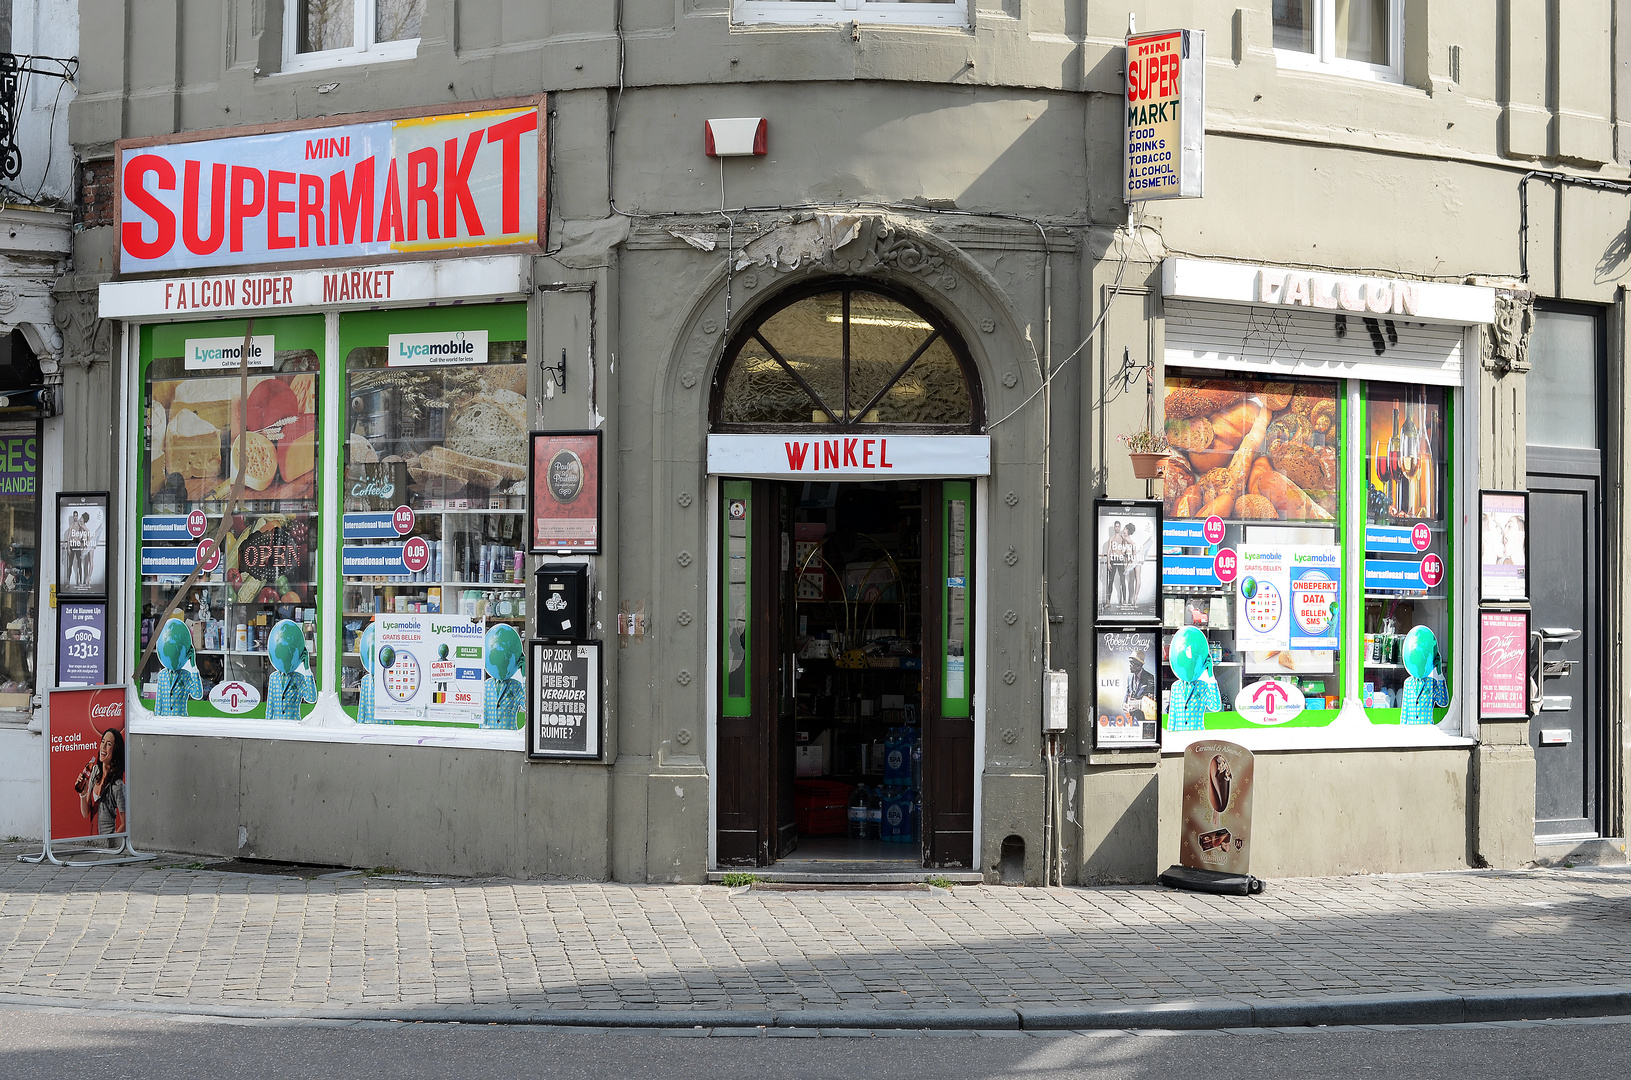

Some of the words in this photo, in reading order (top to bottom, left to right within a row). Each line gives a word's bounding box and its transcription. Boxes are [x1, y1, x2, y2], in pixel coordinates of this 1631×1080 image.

[1138, 41, 1170, 56] MINI
[1128, 53, 1180, 102] SUPER
[1128, 100, 1180, 127] MARKT
[1129, 128, 1155, 140] FOOD
[305, 136, 350, 160] MINI
[1129, 139, 1166, 154] DRINKS
[1129, 151, 1171, 166] TOBACCO
[1128, 163, 1174, 178] ALCOHOL
[121, 110, 538, 259] SUPERMARKT
[164, 279, 236, 309] FALCON
[241, 276, 293, 307] SUPER
[323, 270, 394, 302] MARKET
[399, 339, 474, 359] Lycamobile
[785, 437, 893, 471] WINKEL
[0, 476, 36, 493] HANDE
[351, 483, 381, 497] Coffee
[190, 516, 203, 525] 0.05
[397, 512, 411, 521] 0.05
[344, 521, 378, 529] Internationaal
[1208, 521, 1222, 531] 0.05
[71, 529, 96, 539] Beyond
[1415, 528, 1427, 539] 0.05
[70, 539, 80, 547] the
[82, 538, 97, 547] Tutu
[244, 545, 301, 567] OPEN
[407, 546, 424, 557] 0.05
[1110, 553, 1124, 562] the
[1127, 552, 1145, 562] Tutu
[1245, 552, 1282, 561] Lycamobile
[142, 556, 180, 566] Internationaal
[180, 556, 195, 565] vanaf
[344, 556, 385, 566] Internationaal
[385, 556, 401, 565] vanaf
[1218, 556, 1235, 568] 0.05
[1294, 553, 1336, 563] Lycamobile
[1424, 562, 1440, 573] 0.05
[1366, 570, 1404, 579] Internationaal
[1293, 582, 1337, 590] ONBEPERKT
[1303, 594, 1325, 603] DATA
[382, 621, 421, 630] Lycamobile
[431, 623, 483, 634] Lycamobile
[75, 632, 92, 642] 0800
[1104, 632, 1131, 651] Robert
[1130, 633, 1151, 651] Cray
[1482, 631, 1521, 655] Dirty
[68, 642, 99, 659] 12312
[542, 649, 553, 661] OP
[554, 649, 572, 661] ZOEK
[1487, 644, 1525, 671] Dancing
[542, 662, 563, 674] NAAR
[541, 675, 578, 688] FEEST
[1101, 679, 1120, 687] LIVE
[231, 693, 237, 708] 0
[455, 693, 471, 701] SMS
[541, 689, 586, 700] VERGADER
[1494, 692, 1508, 701] JUNE
[1509, 692, 1523, 701] 2014
[541, 701, 586, 713] REPETEER
[1266, 693, 1274, 714] 0
[541, 714, 583, 727] HOBBY
[51, 734, 63, 743] ice
[64, 733, 81, 742] cold
[541, 727, 573, 739] RUIMTE?
[51, 741, 97, 752] refreshment
[1195, 745, 1216, 753] Caramel
[1222, 747, 1243, 758] Almonds
[888, 811, 901, 819] SPA
